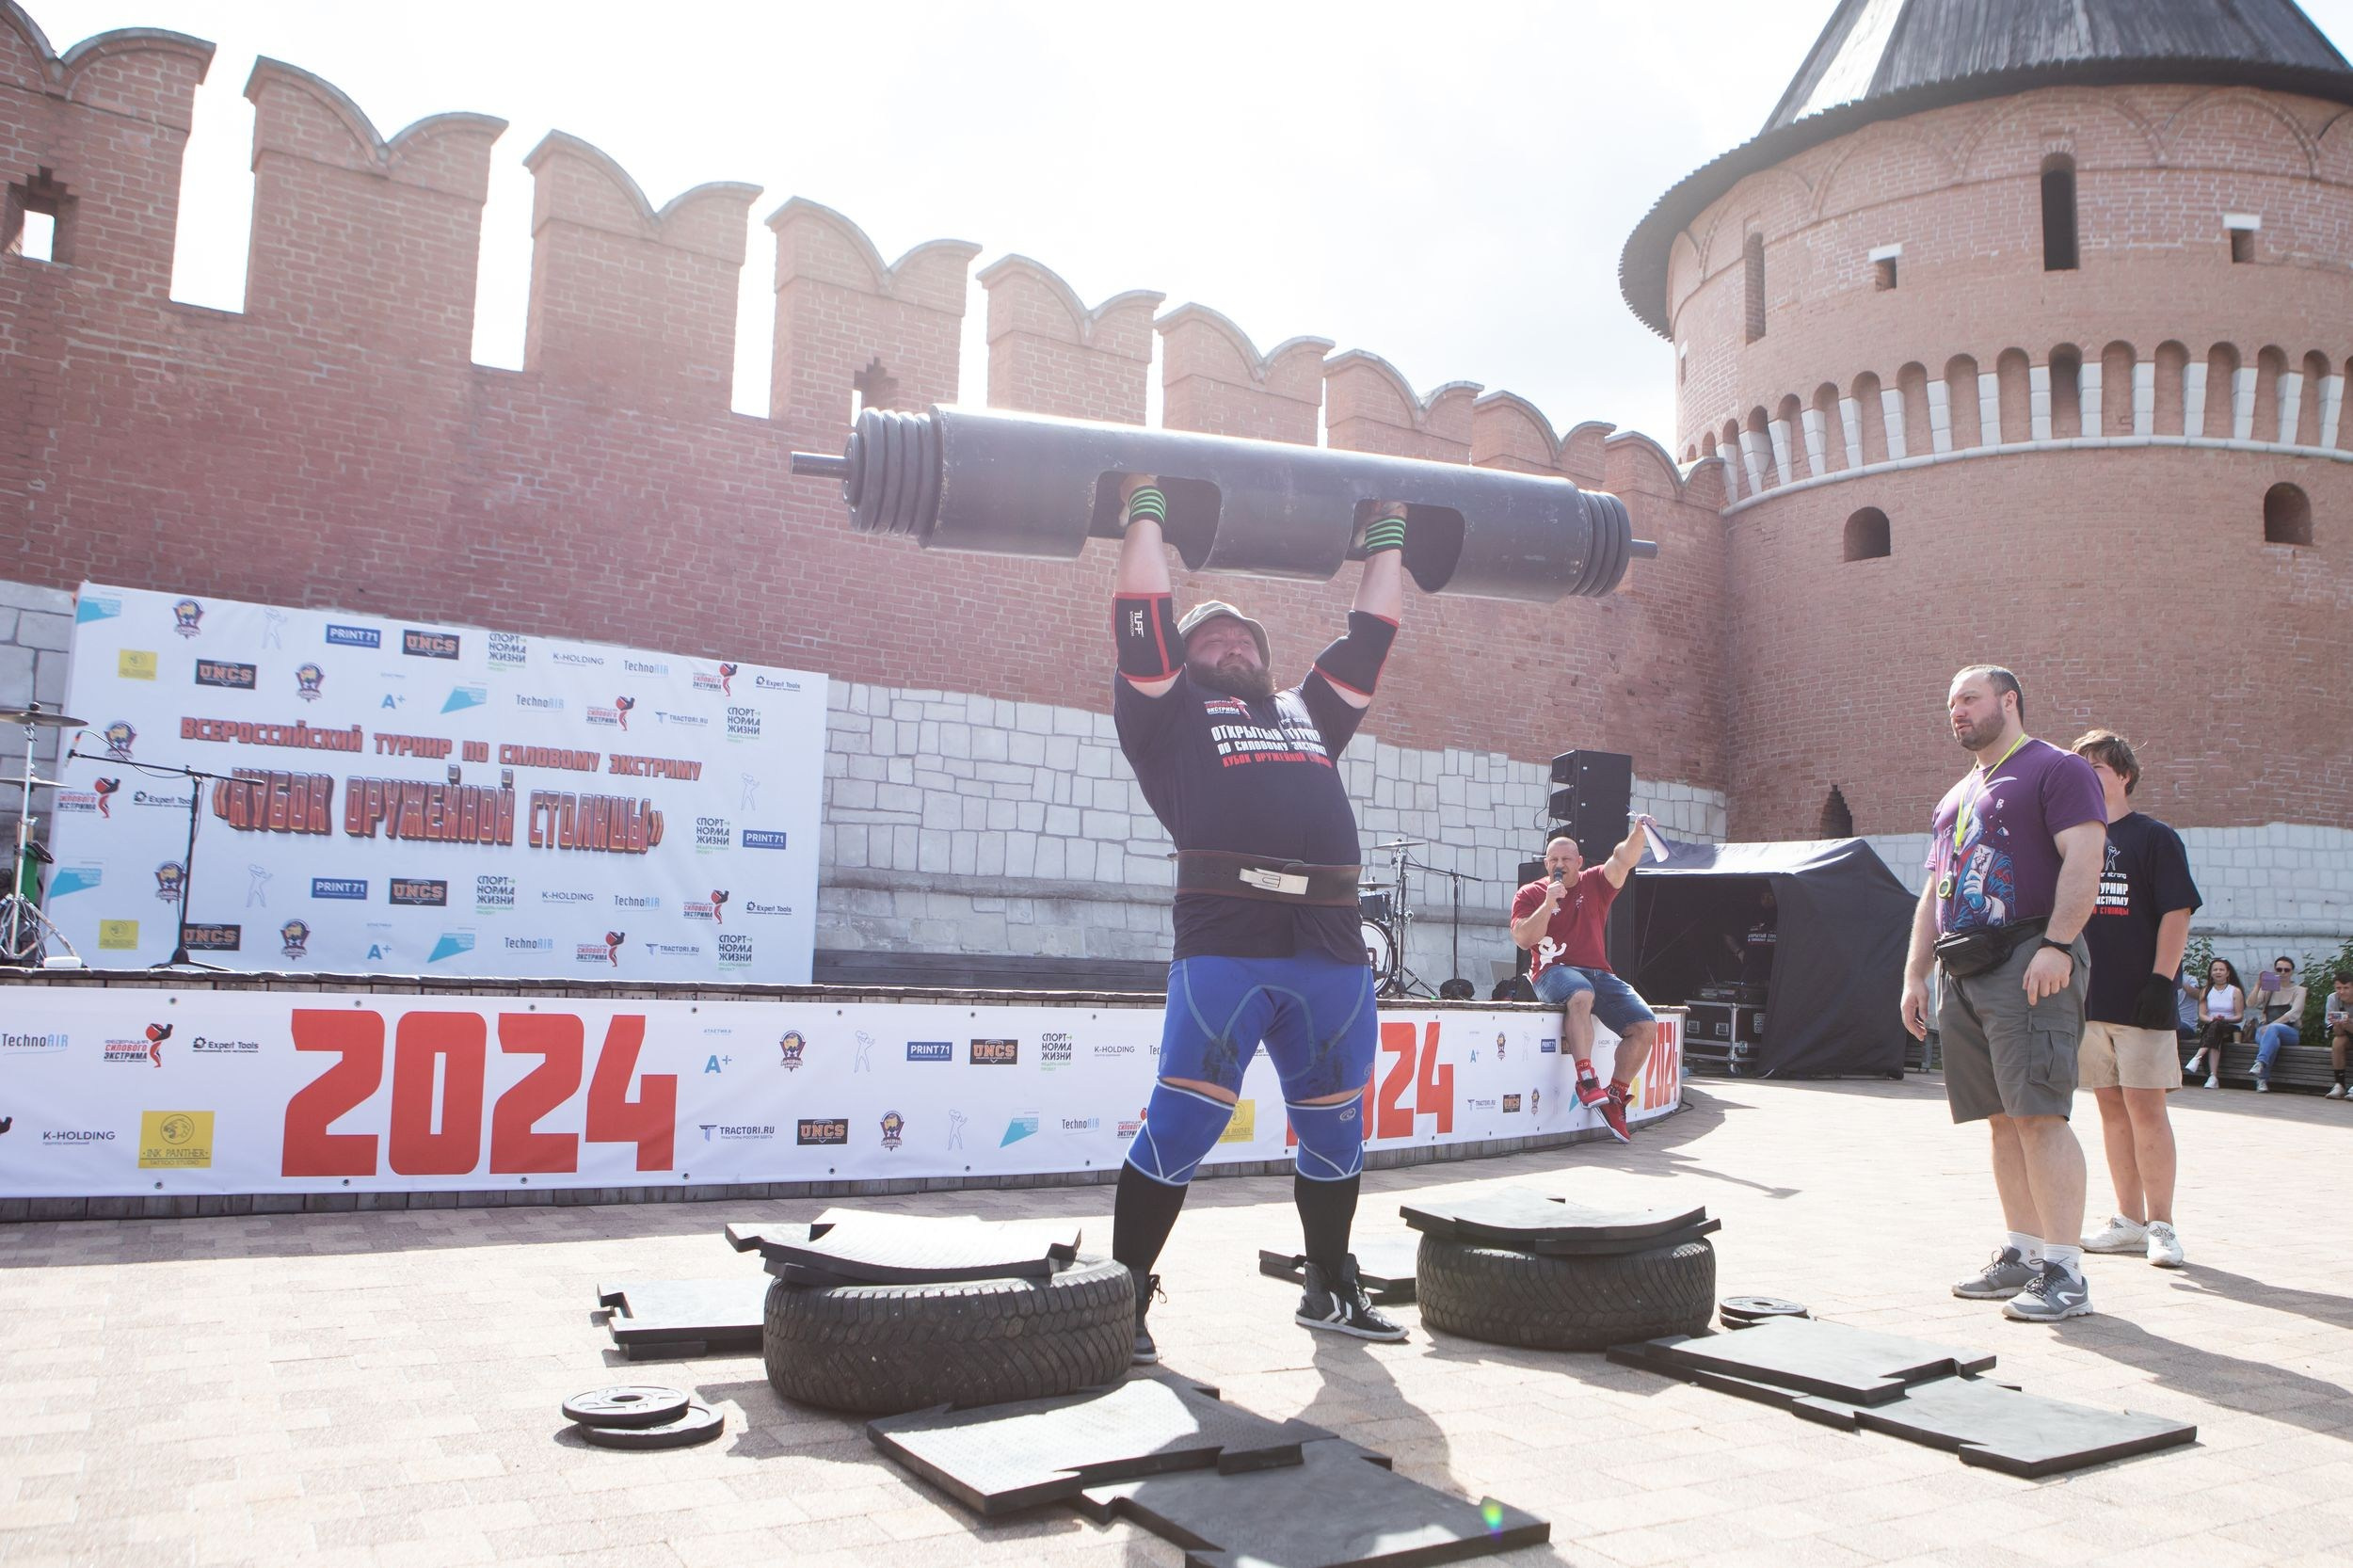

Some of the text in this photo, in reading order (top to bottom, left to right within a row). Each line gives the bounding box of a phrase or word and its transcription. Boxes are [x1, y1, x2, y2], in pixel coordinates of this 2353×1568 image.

[329, 627, 364, 641] PRINT
[488, 632, 520, 645] СПОРТ
[406, 634, 456, 651] UNCS
[488, 642, 527, 655] НОРМА
[488, 650, 526, 664] ЖИЗНИ
[552, 651, 604, 666] K-HOLDING
[199, 664, 253, 682] UNCS
[727, 706, 756, 717] СПОРТ
[585, 715, 617, 726] ЭКСТРИМА
[727, 715, 760, 727] НОРМА
[727, 724, 760, 736] ЖИЗНИ
[1210, 724, 1285, 742] ОТКРЫТЫЙ
[180, 716, 702, 781] ВСЕРОССИЙСКИЙ ТУРНИР ПО СИЛОВОМУ ЭКСТРИМУ
[1217, 741, 1232, 756] ПО
[1234, 740, 1289, 752] СИЛОВОМУ
[1223, 753, 1252, 768] КУБОК
[149, 794, 175, 806] Expert
[696, 817, 725, 828] СПОРТ
[696, 825, 730, 837] НОРМА
[696, 834, 729, 846] ЖИЗНИ
[746, 833, 774, 844] PRINT
[775, 834, 785, 844] 71
[476, 874, 508, 886] СПОРТ
[315, 881, 366, 893] PRINT 71
[392, 884, 444, 900] UNCS
[476, 885, 516, 896] НОРМА
[2100, 882, 2129, 895] УРНИР
[476, 894, 515, 905] ЖИЗНИ
[541, 890, 594, 902] K-HOLDING
[2095, 895, 2129, 906] КСТРИМУ
[682, 910, 713, 919] ЭКСТРИМА
[757, 904, 776, 914] Expert
[719, 935, 746, 944] СПОРТ
[660, 944, 700, 954] TRACTORI.RU
[718, 944, 752, 953] НОРМА
[576, 952, 608, 961] ЭКСТРИМА
[718, 952, 752, 962] ЖИЗНИ
[1, 1033, 69, 1048] TechnoAIR
[1042, 1032, 1067, 1043] СПОРТ
[104, 1044, 148, 1052] СИЛОВОГО
[208, 1041, 259, 1050] Expert Tools
[910, 1045, 950, 1055] PRINT 71
[973, 1044, 1016, 1058] UNCS
[1041, 1042, 1072, 1051] НОРМА
[1094, 1046, 1135, 1054] K-HOLDING
[104, 1051, 148, 1061] ЭКСТРИМА
[1041, 1051, 1072, 1061] ЖИЗНИ
[280, 1008, 678, 1176] 2024
[1062, 1117, 1100, 1130] TechnoAIR
[42, 1130, 116, 1141] K-HOLDING
[719, 1125, 776, 1135] TRACTORI.RU
[800, 1123, 845, 1138] UNCS
[166, 1148, 205, 1158] PANTHER
